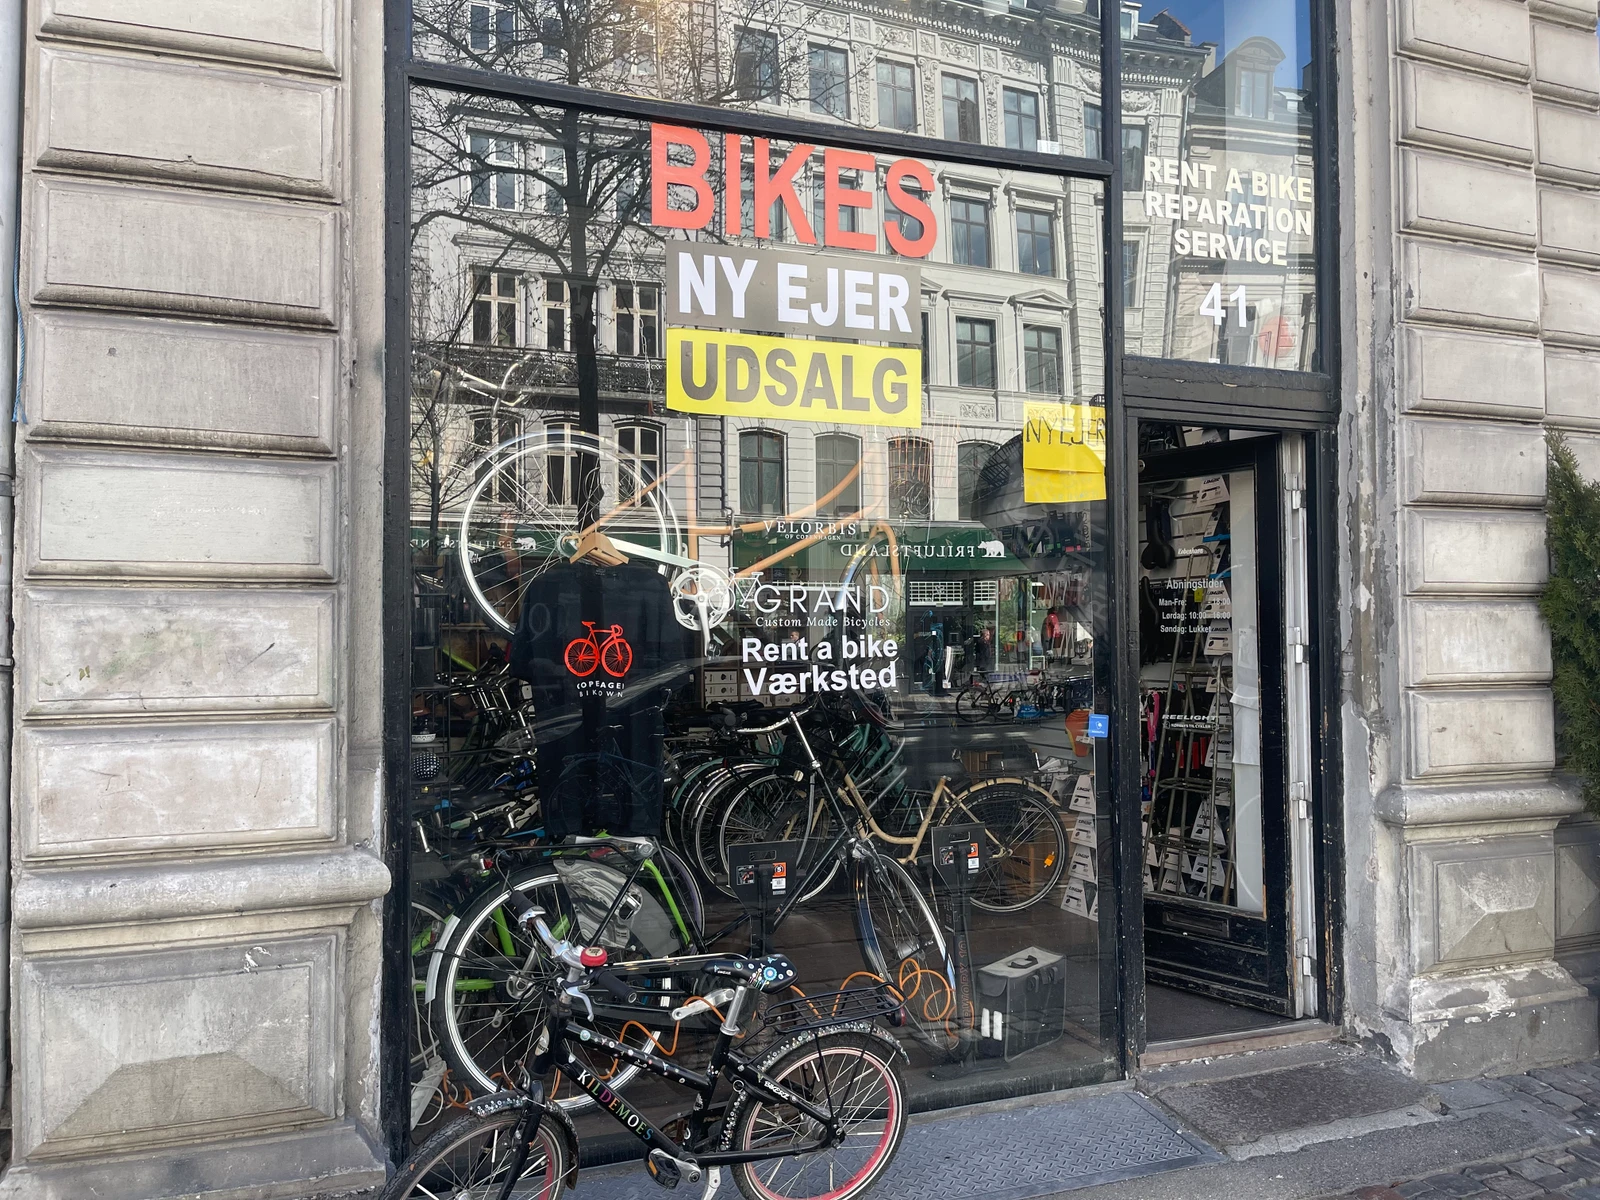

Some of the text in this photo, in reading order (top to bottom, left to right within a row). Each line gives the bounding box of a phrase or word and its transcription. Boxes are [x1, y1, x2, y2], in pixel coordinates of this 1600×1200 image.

[652, 123, 938, 258] BIKES
[1144, 155, 1312, 203] RENT A BIKE
[1146, 190, 1312, 236] REPARATION
[1174, 228, 1288, 266] SERVICE
[678, 252, 913, 333] NY EJER
[1199, 282, 1247, 328] 41
[680, 340, 909, 414] UDSALG
[763, 520, 857, 535] VELORBIS
[754, 583, 891, 614] GRAND
[1166, 577, 1224, 591] Åbningstider
[755, 616, 891, 630] Custom Made Bicycles
[742, 634, 898, 663] Rent a bike
[743, 661, 897, 696] Værksted
[577, 1069, 654, 1140] KILDEMOES
